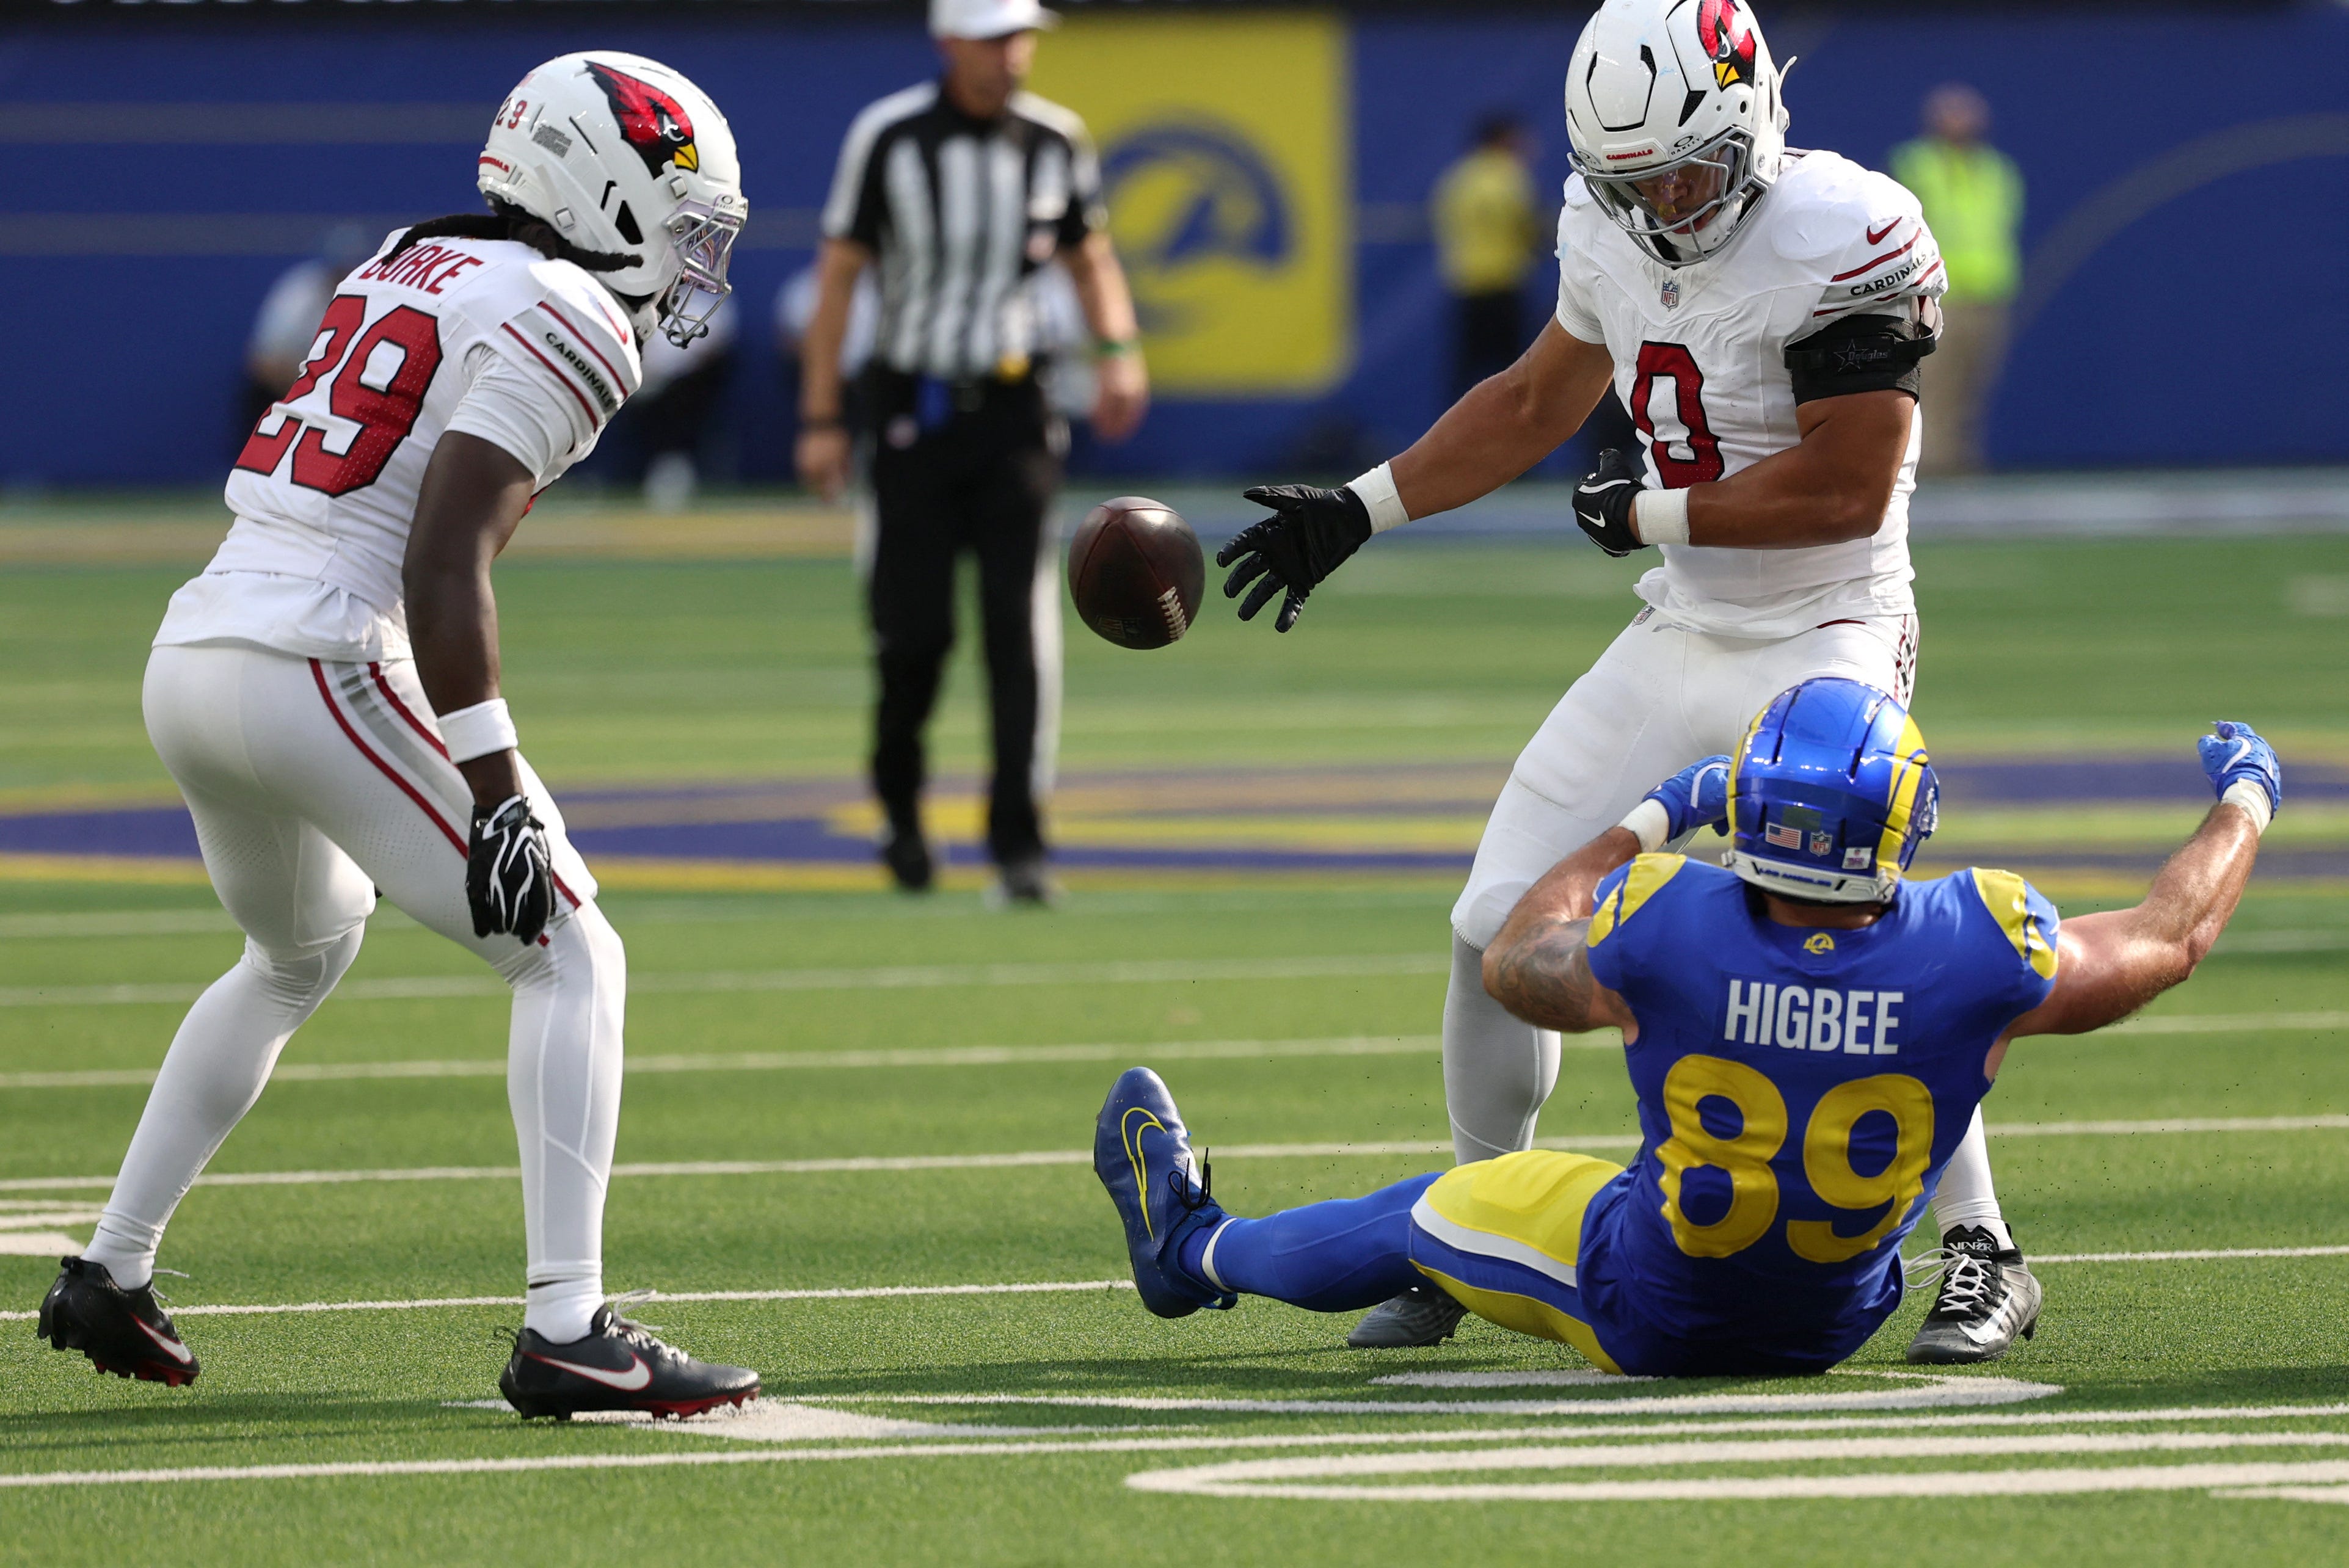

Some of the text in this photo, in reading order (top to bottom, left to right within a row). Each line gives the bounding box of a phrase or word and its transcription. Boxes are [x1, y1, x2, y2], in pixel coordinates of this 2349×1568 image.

[495, 97, 528, 130] 29
[1606, 148, 1654, 161] CARDINALS
[1850, 253, 1927, 296] CARDINALS
[234, 294, 443, 498] 29
[1630, 339, 1725, 490] 0
[1724, 979, 1904, 1054] HIGBEE
[1655, 1053, 1934, 1264] 89
